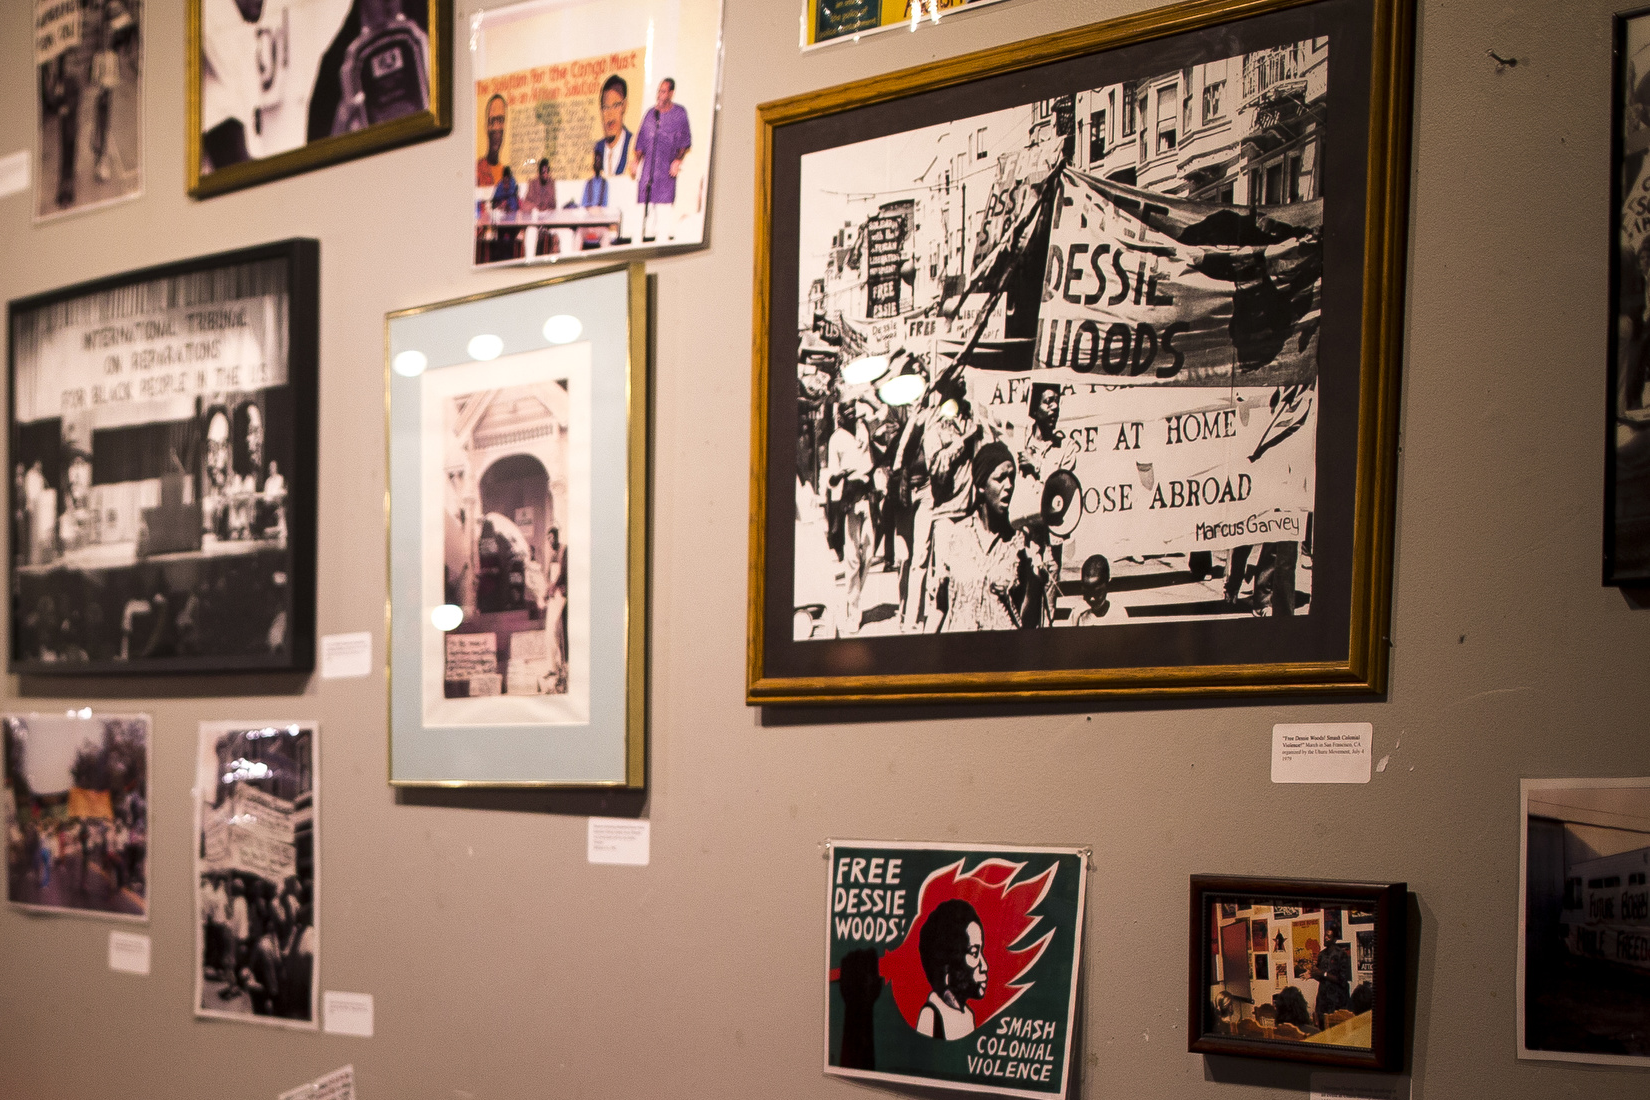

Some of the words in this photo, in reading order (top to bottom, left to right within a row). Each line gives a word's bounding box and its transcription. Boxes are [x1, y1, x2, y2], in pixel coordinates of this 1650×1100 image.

[550, 65, 568, 82] the
[570, 58, 606, 80] Congo
[610, 52, 637, 70] Must
[1042, 243, 1177, 307] DESSIE
[872, 281, 896, 300] FREE
[872, 301, 898, 319] ESSIE
[83, 318, 176, 350] INTERNATIONAL
[185, 308, 247, 332] TRIBUNAL
[908, 320, 937, 338] FREE
[105, 354, 123, 376] ON
[131, 339, 222, 371] REPARATIONS
[1033, 317, 1191, 379] WOODS
[61, 387, 87, 410] FOR
[91, 381, 132, 405] BLACK
[140, 372, 188, 397] PEOPLE
[1113, 422, 1145, 451] AT
[1165, 410, 1237, 446] HOME
[1149, 473, 1253, 511] ABROAD
[1196, 521, 1245, 542] Marcus
[1246, 514, 1300, 537] Garvey
[835, 857, 903, 885] FREE
[834, 887, 906, 916] DESSIE
[834, 915, 907, 944] WOODS!
[1615, 930, 1650, 962] FREED
[996, 1016, 1056, 1040] SMASH
[976, 1035, 1055, 1062] COLONIAL
[966, 1054, 1053, 1082] VIOLENCE
